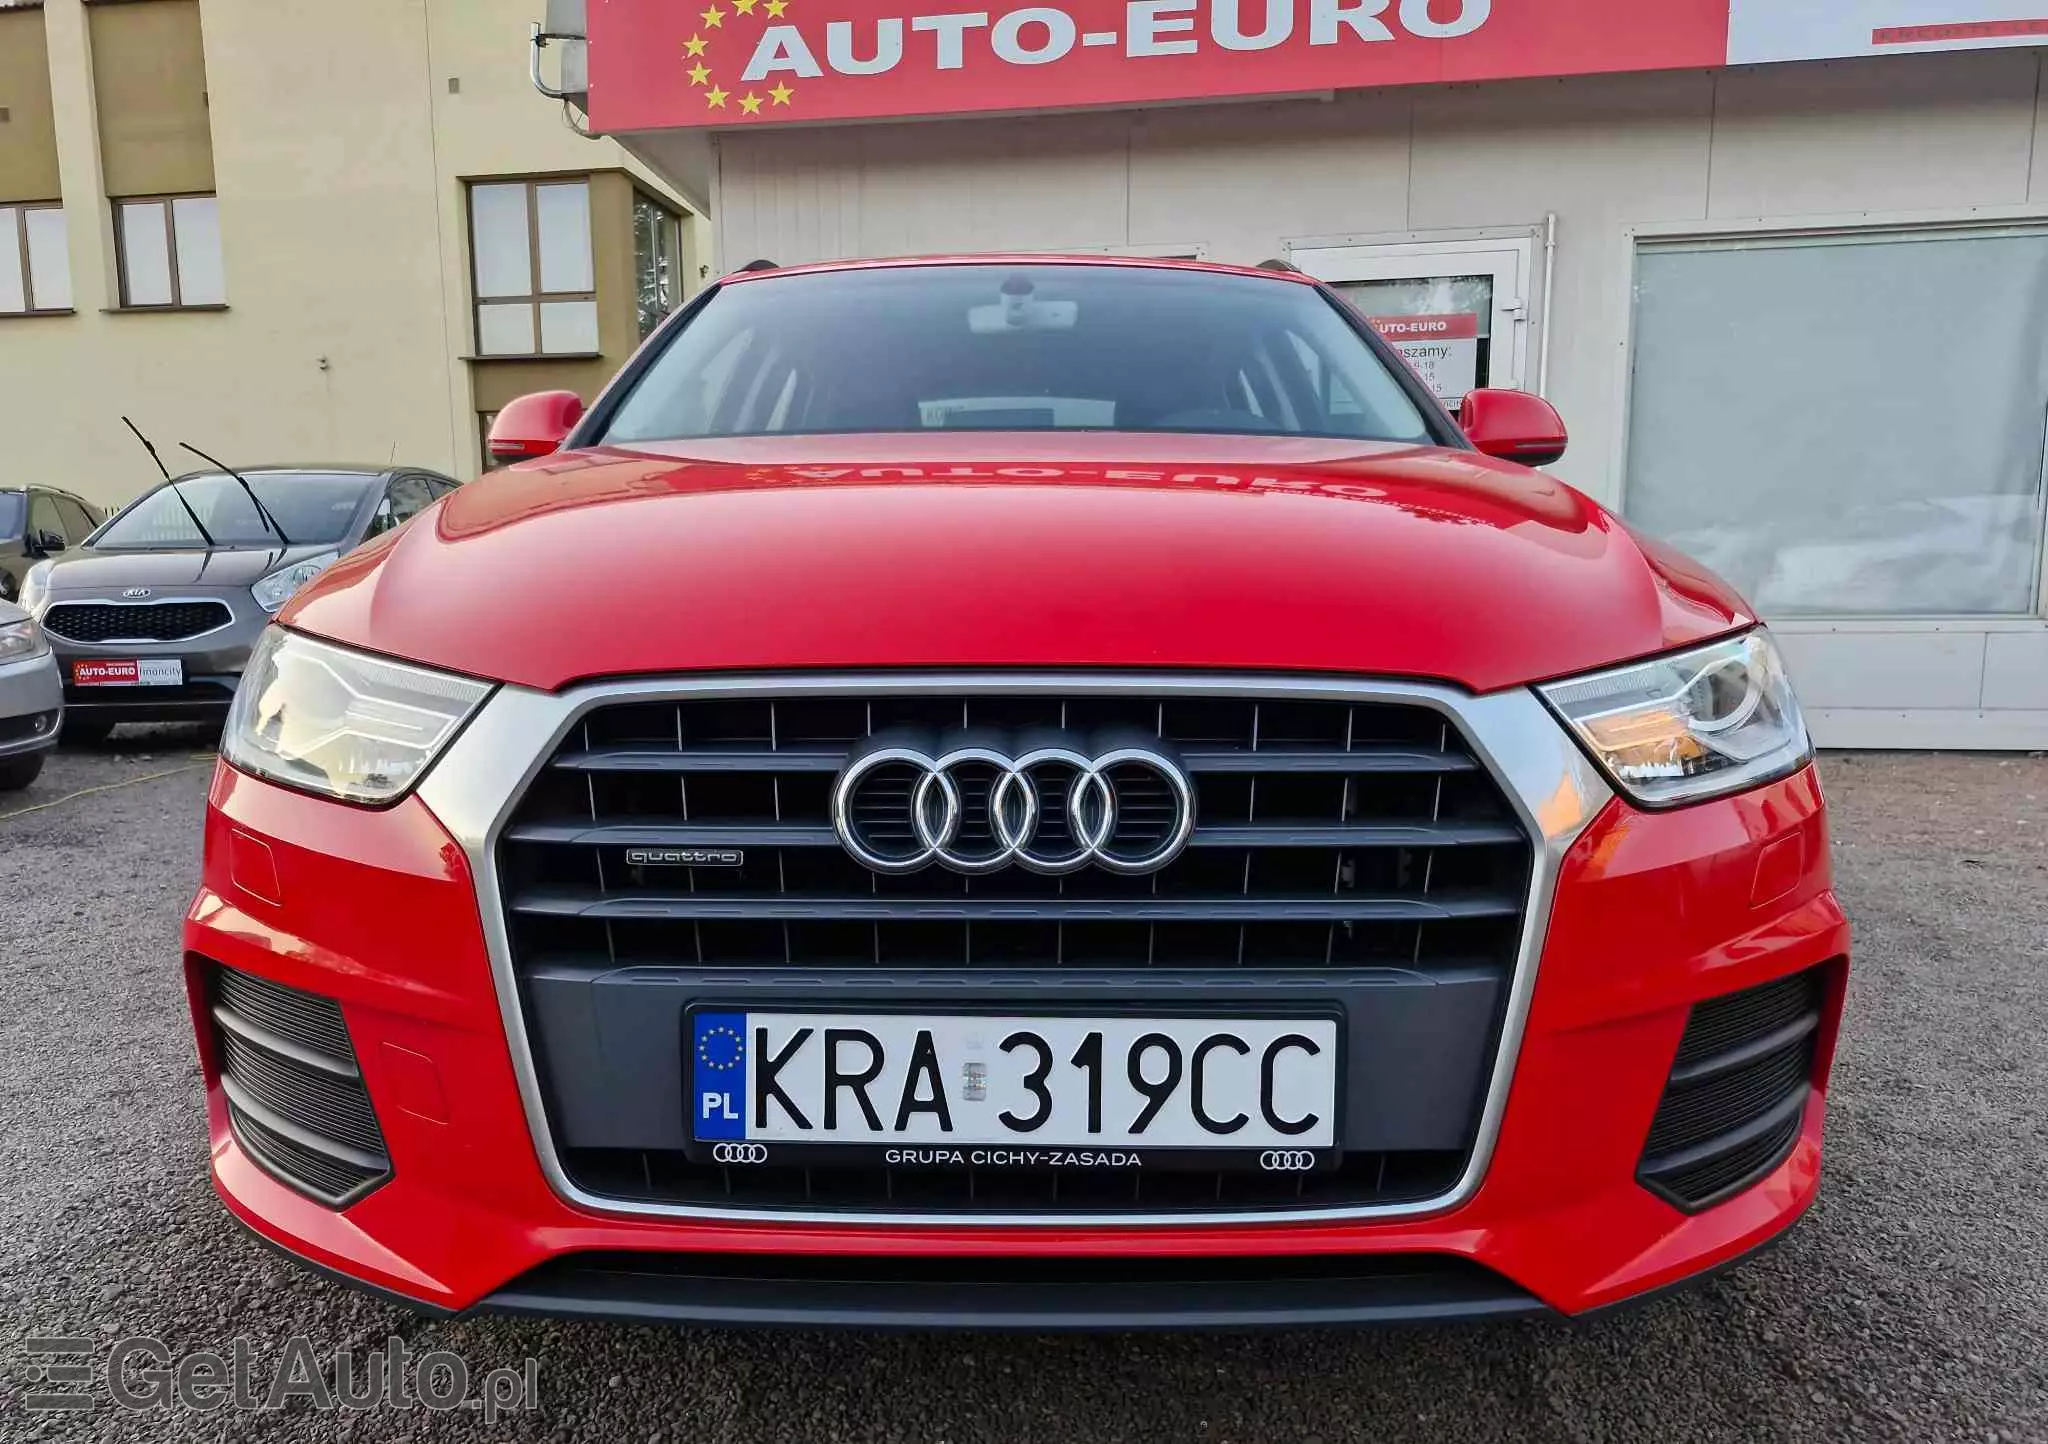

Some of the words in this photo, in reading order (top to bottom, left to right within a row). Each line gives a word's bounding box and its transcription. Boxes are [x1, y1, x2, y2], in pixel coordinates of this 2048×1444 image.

[740, 0, 1492, 82] AUTO-EURO
[1377, 320, 1447, 333] UTO-EURO
[79, 666, 136, 676] AUTO-EURO
[631, 852, 737, 863] quattro
[754, 1027, 954, 1132] KRA
[997, 1031, 1321, 1135] 319CC
[703, 1092, 739, 1119] PL
[885, 1149, 965, 1164] GRUPA
[970, 1150, 1142, 1166] CICHY-ZASADA
